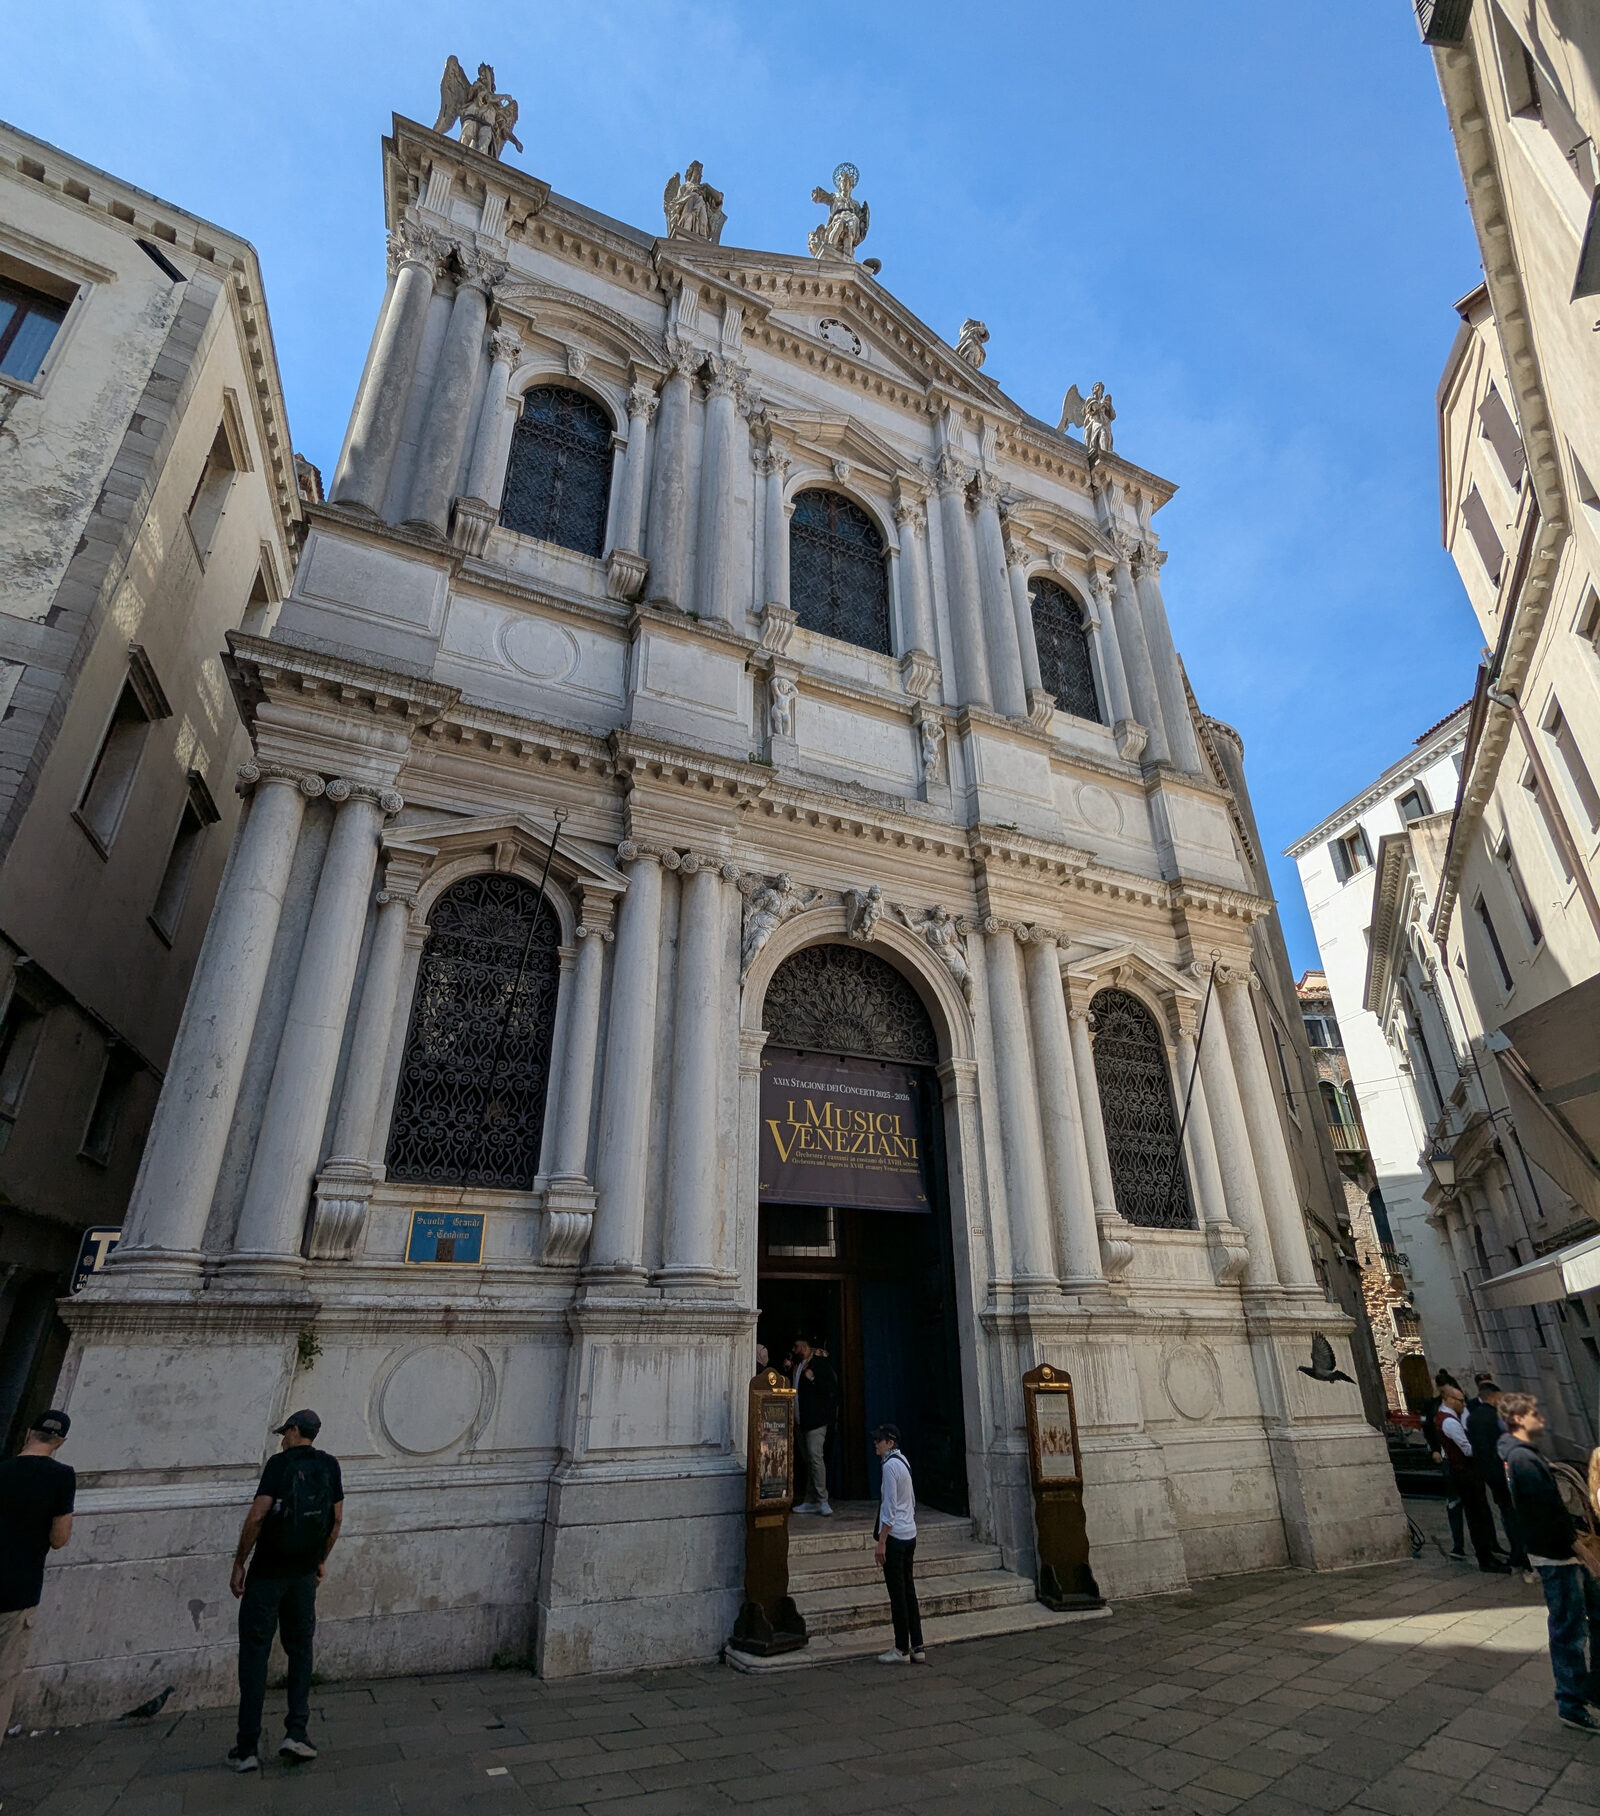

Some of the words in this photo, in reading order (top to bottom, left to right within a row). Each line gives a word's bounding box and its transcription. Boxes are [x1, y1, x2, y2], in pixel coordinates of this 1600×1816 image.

[773, 1077, 790, 1086] XXIX
[791, 1078, 826, 1091] STAGIONE
[827, 1084, 839, 1093] DEI
[840, 1084, 875, 1097] CONCERTI
[876, 1090, 891, 1099] 2025
[895, 1092, 910, 1101] 2026
[787, 1100, 796, 1122] I
[804, 1099, 902, 1136] MUSICI
[765, 1119, 918, 1163] VENEZIANI
[417, 1216, 445, 1225] Scuola
[90, 1232, 122, 1272] T
